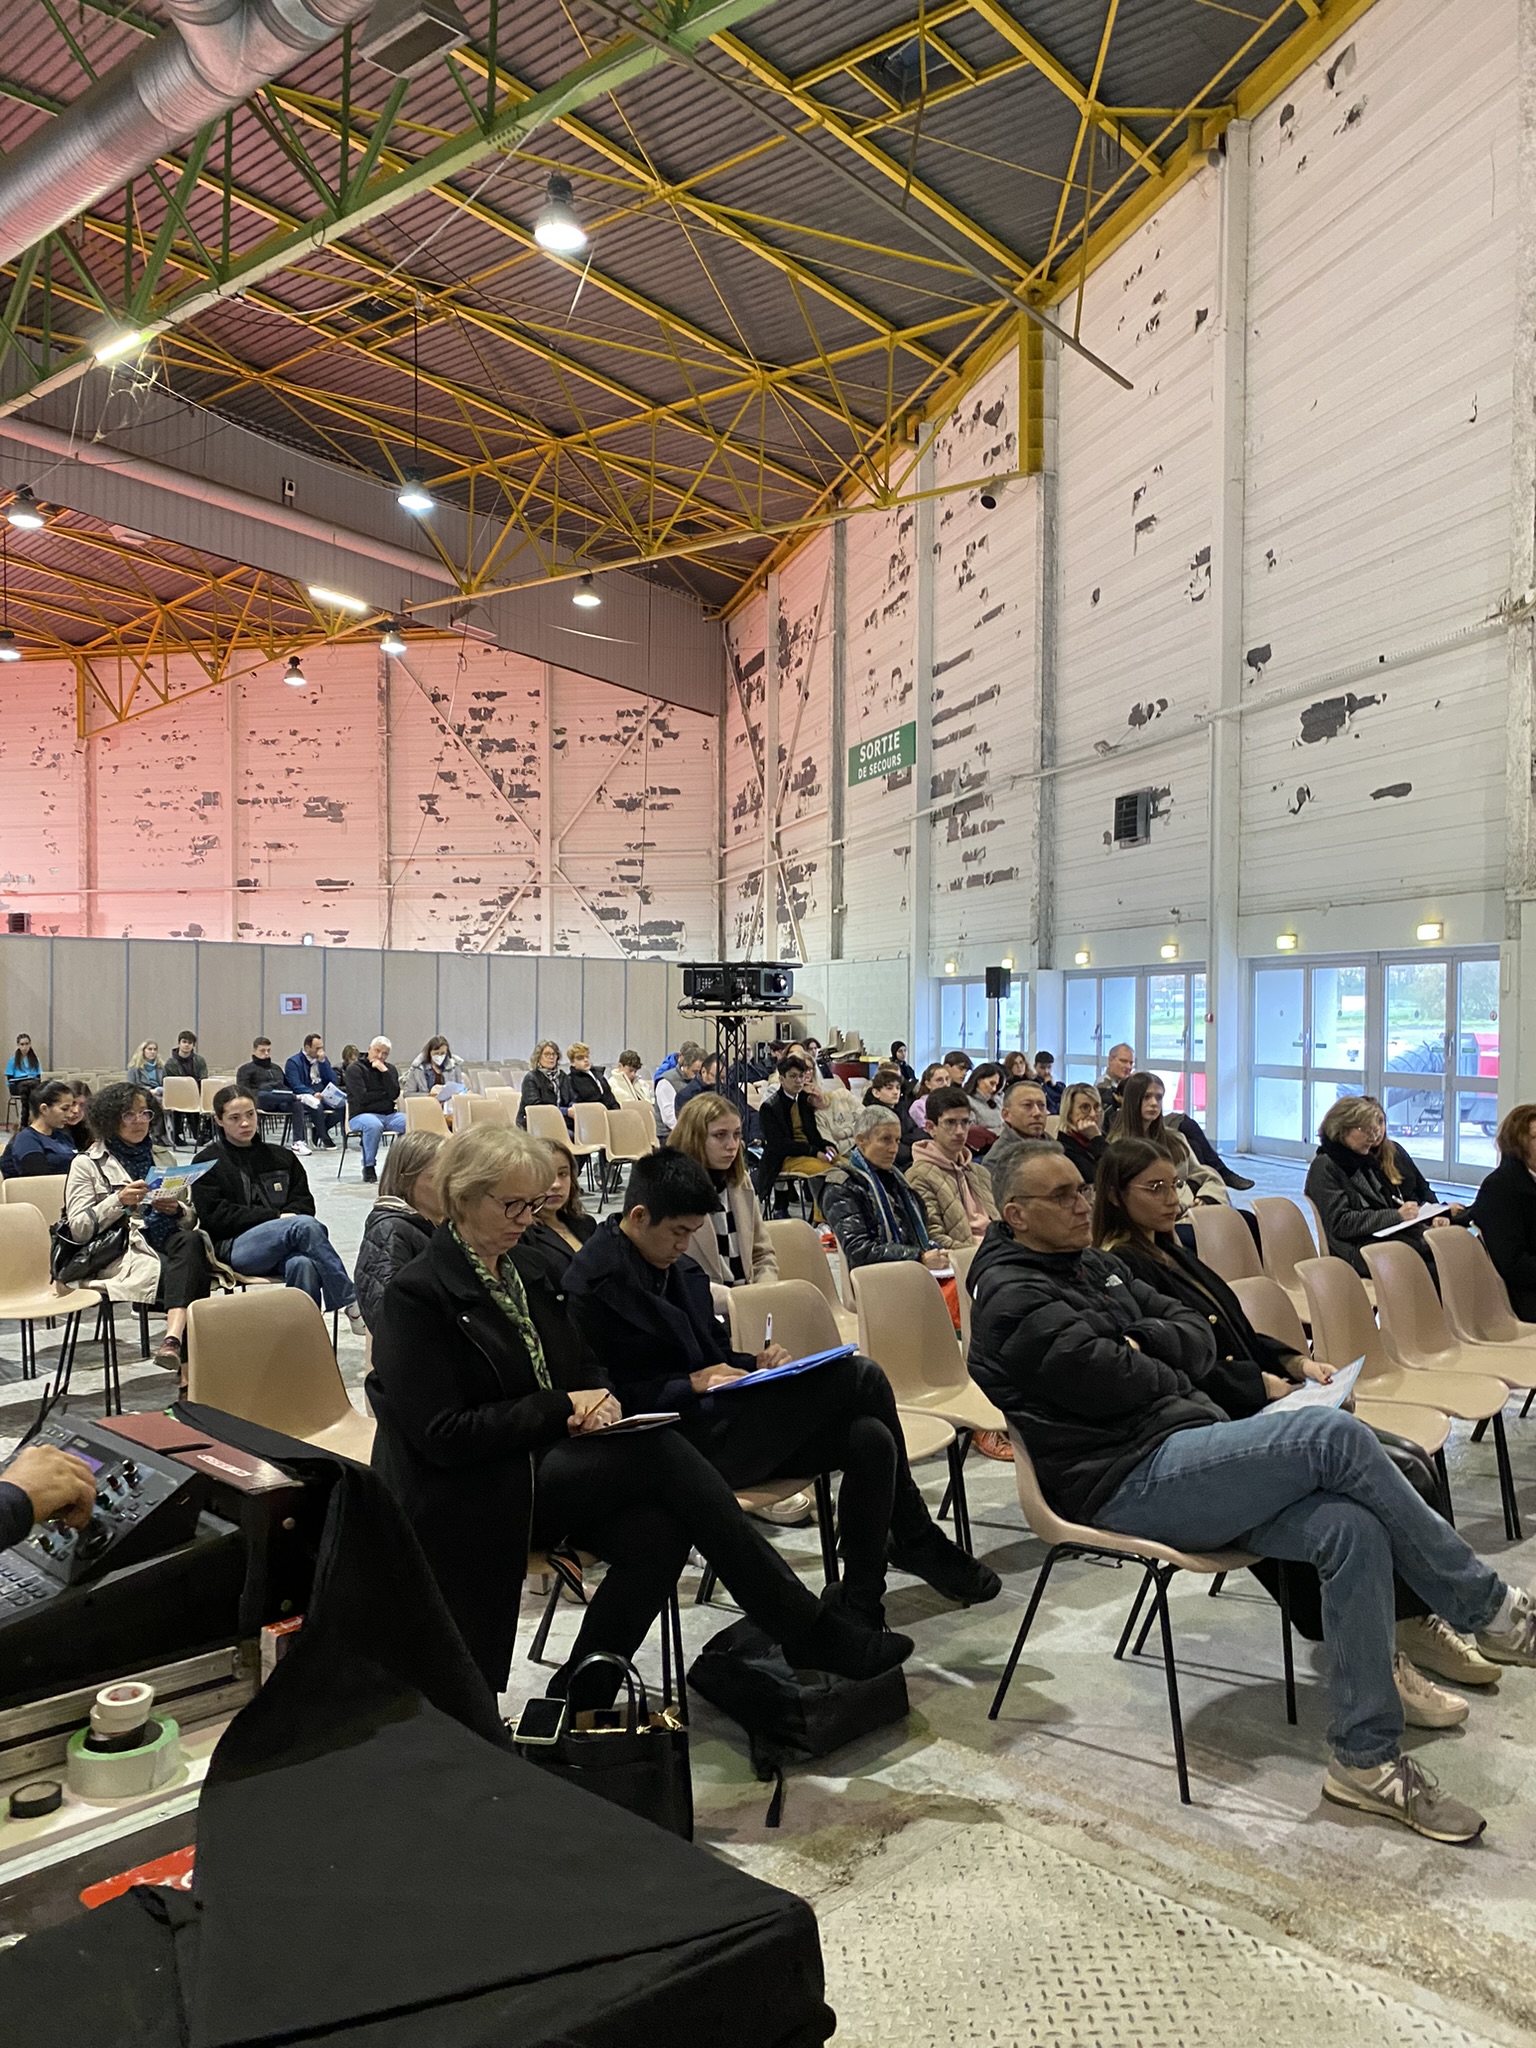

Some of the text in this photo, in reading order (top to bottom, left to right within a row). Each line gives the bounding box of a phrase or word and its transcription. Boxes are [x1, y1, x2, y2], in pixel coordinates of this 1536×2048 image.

[859, 730, 900, 763] SORTIE
[858, 753, 902, 780] DE SECOURS
